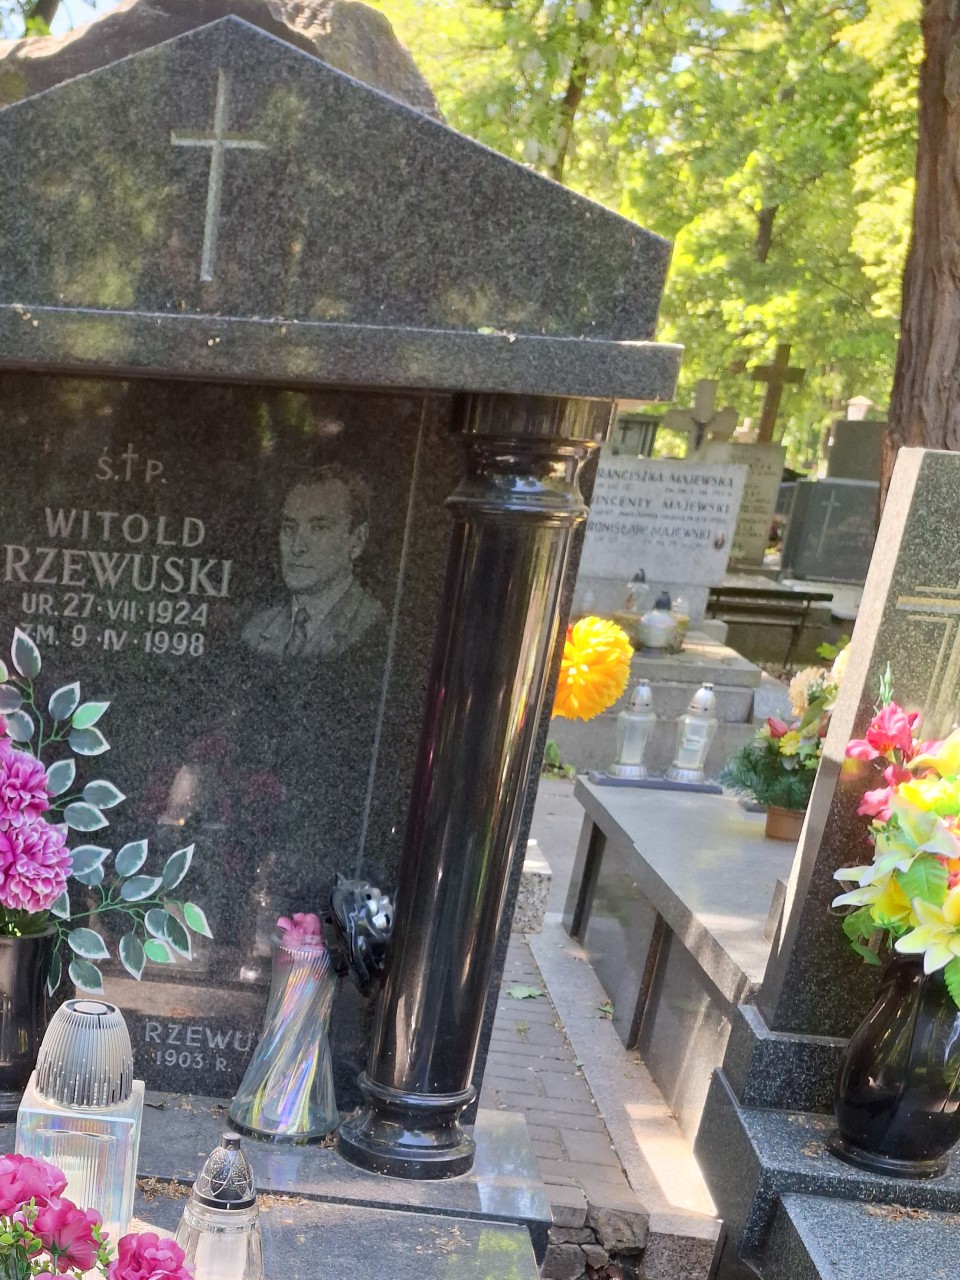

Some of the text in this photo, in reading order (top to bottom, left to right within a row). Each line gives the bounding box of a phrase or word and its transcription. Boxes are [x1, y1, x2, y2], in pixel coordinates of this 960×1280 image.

[44, 507, 205, 547] WITOLD
[3, 544, 233, 598] RZEWUSKI
[144, 1020, 254, 1052] RZEWU
[155, 1049, 204, 1069] 1903
